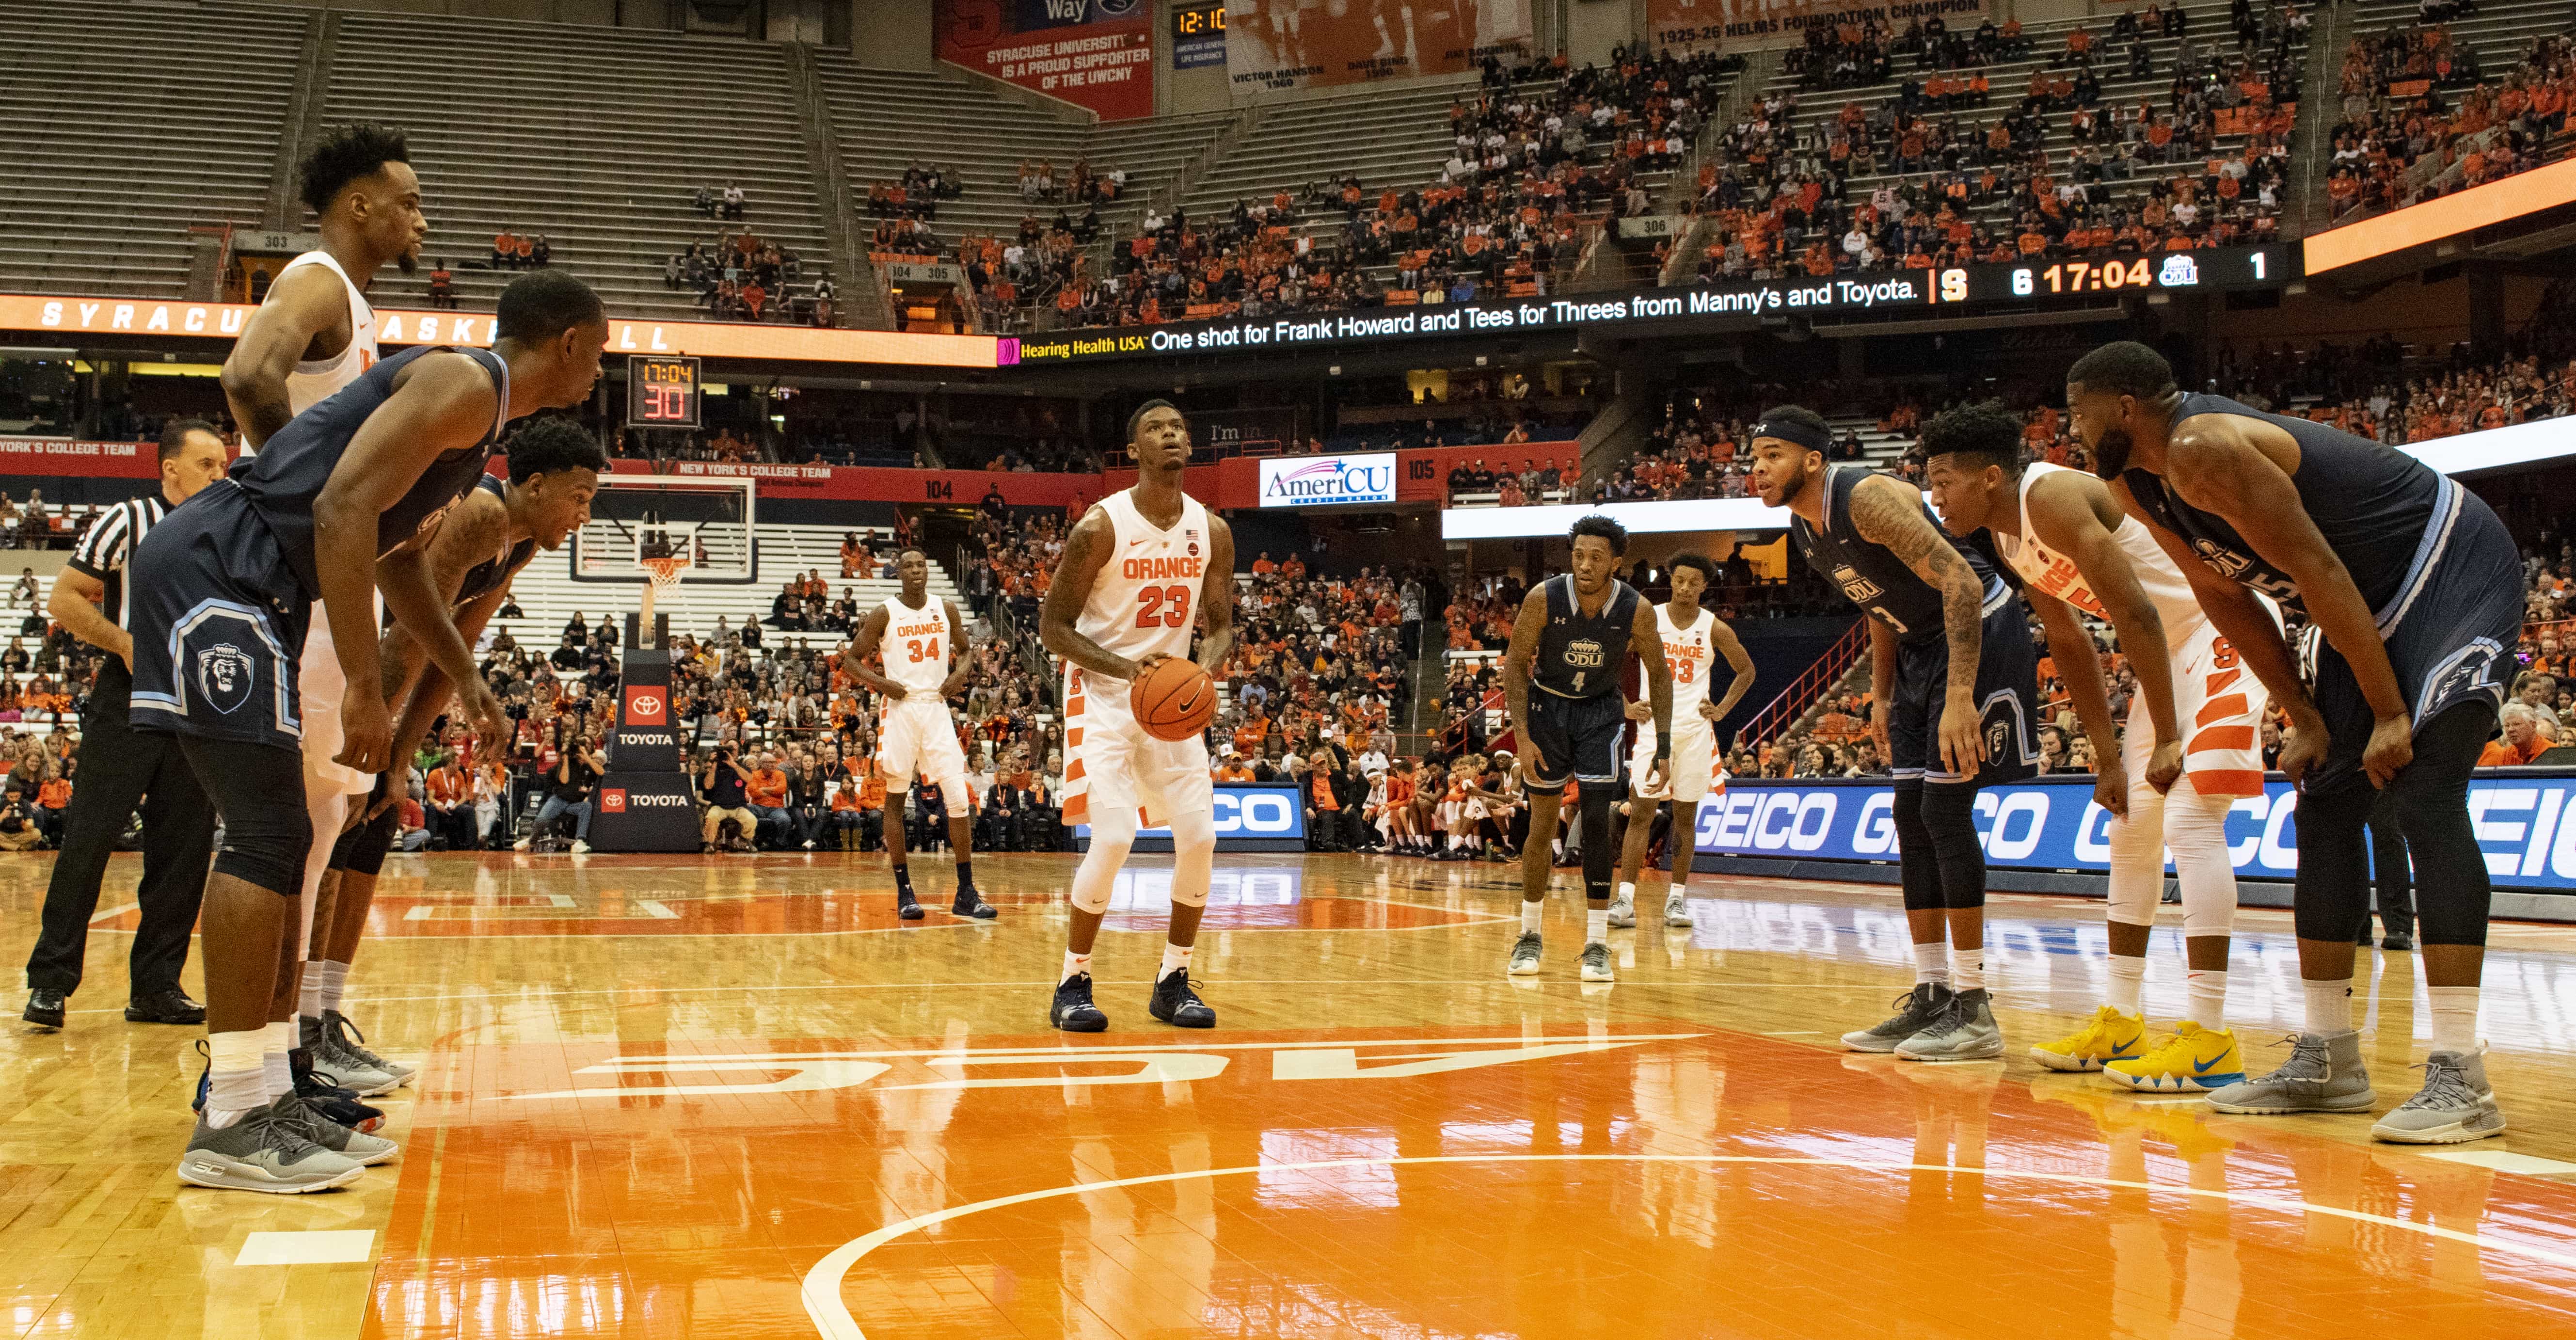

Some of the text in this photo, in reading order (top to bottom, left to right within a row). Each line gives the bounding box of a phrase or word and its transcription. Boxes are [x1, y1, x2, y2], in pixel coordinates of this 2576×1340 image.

[1046, 0, 1086, 22] Way
[1180, 8, 1225, 33] 12:10
[1658, 27, 1720, 43] 1925-26
[1726, 20, 1779, 37] HELMS
[987, 43, 1051, 64] SYRACUSE
[1002, 48, 1150, 78] IS A PROUD SUPPORTER
[1348, 61, 1376, 70] DAVE
[1042, 66, 1133, 89] OF THE UWCNY
[1233, 71, 1272, 83] VICTOR
[1266, 79, 1294, 89] 1960
[1644, 220, 1666, 232] 306
[265, 235, 287, 248] 303
[928, 266, 948, 279] 305
[2013, 269, 2033, 295] 6
[2043, 259, 2151, 293] 17:04
[2250, 252, 2265, 280] 1
[41, 302, 243, 334] SYRACU
[1151, 278, 1918, 351] One shot for Frank Howard and Tees for Threes from Manny's and Toyota.
[1020, 343, 1070, 358] Hearing
[1073, 338, 1115, 354] Health
[644, 365, 692, 383] 17:04
[645, 385, 684, 419] 30
[1211, 425, 1240, 441] I'm
[0, 441, 136, 456] YORK'S COLLEGE TEAM
[680, 463, 831, 478] NEW YORK'S COLLEGE TEAM
[1409, 460, 1434, 480] 105
[925, 480, 953, 499] 104
[1265, 466, 1390, 497] AmeriCU
[1123, 557, 1202, 579] ORANGE
[1135, 585, 1191, 628] 23
[897, 622, 945, 638] ORANGE
[907, 637, 940, 663] 34
[1564, 652, 1603, 667] ODU
[1664, 641, 1705, 659] RANGE
[1571, 671, 1586, 692] 4
[619, 734, 673, 745] TOYOTA
[631, 795, 687, 806] TOYOTA
[1695, 792, 1838, 851] GEICO
